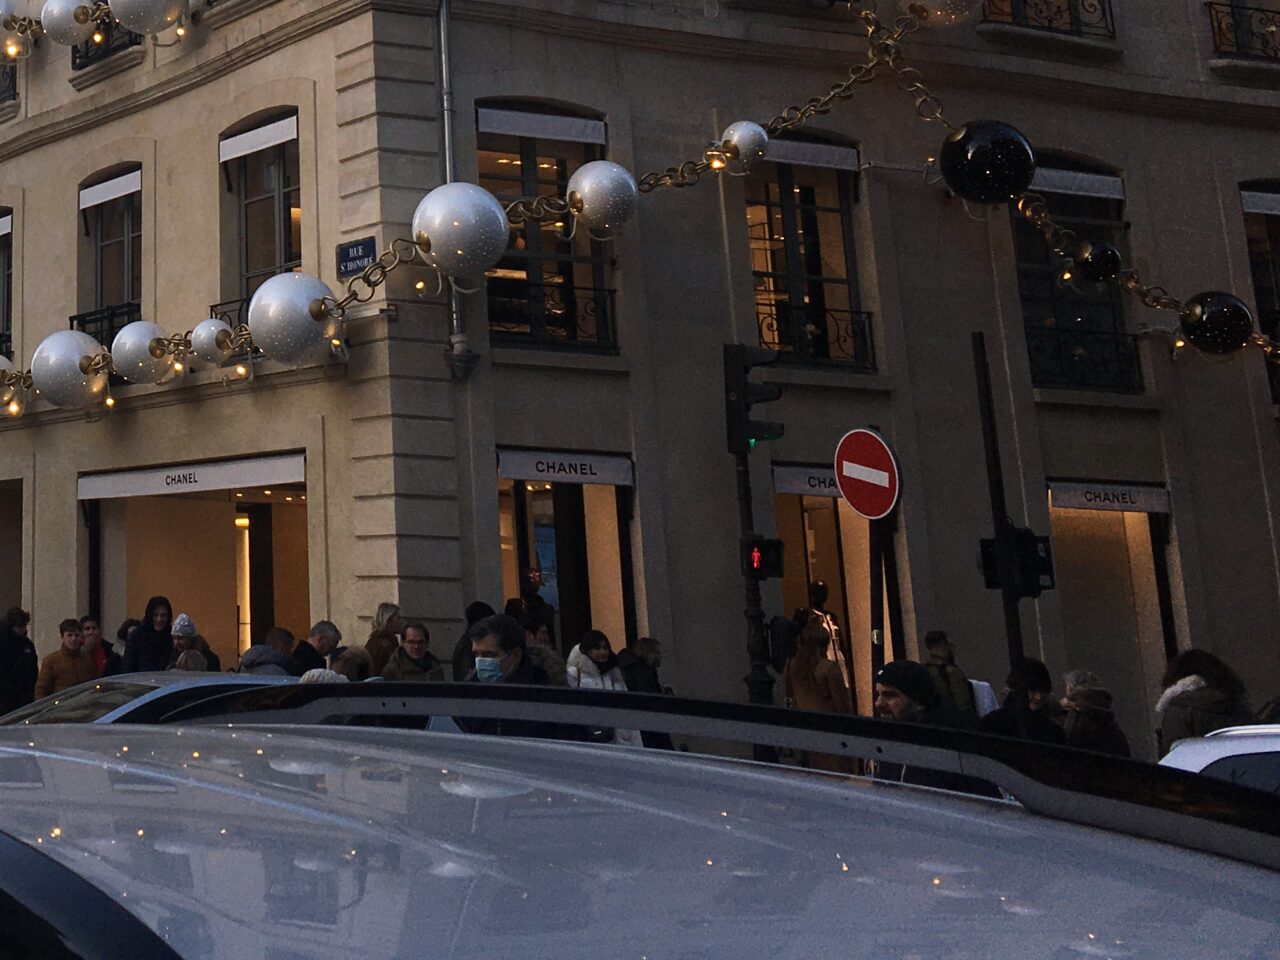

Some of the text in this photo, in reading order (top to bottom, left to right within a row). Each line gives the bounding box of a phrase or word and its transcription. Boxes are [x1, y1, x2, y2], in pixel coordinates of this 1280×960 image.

[349, 245, 364, 258] RUE
[535, 461, 597, 476] CHANEL
[165, 472, 198, 486] CHANEL
[1084, 491, 1136, 504] CHANEL
